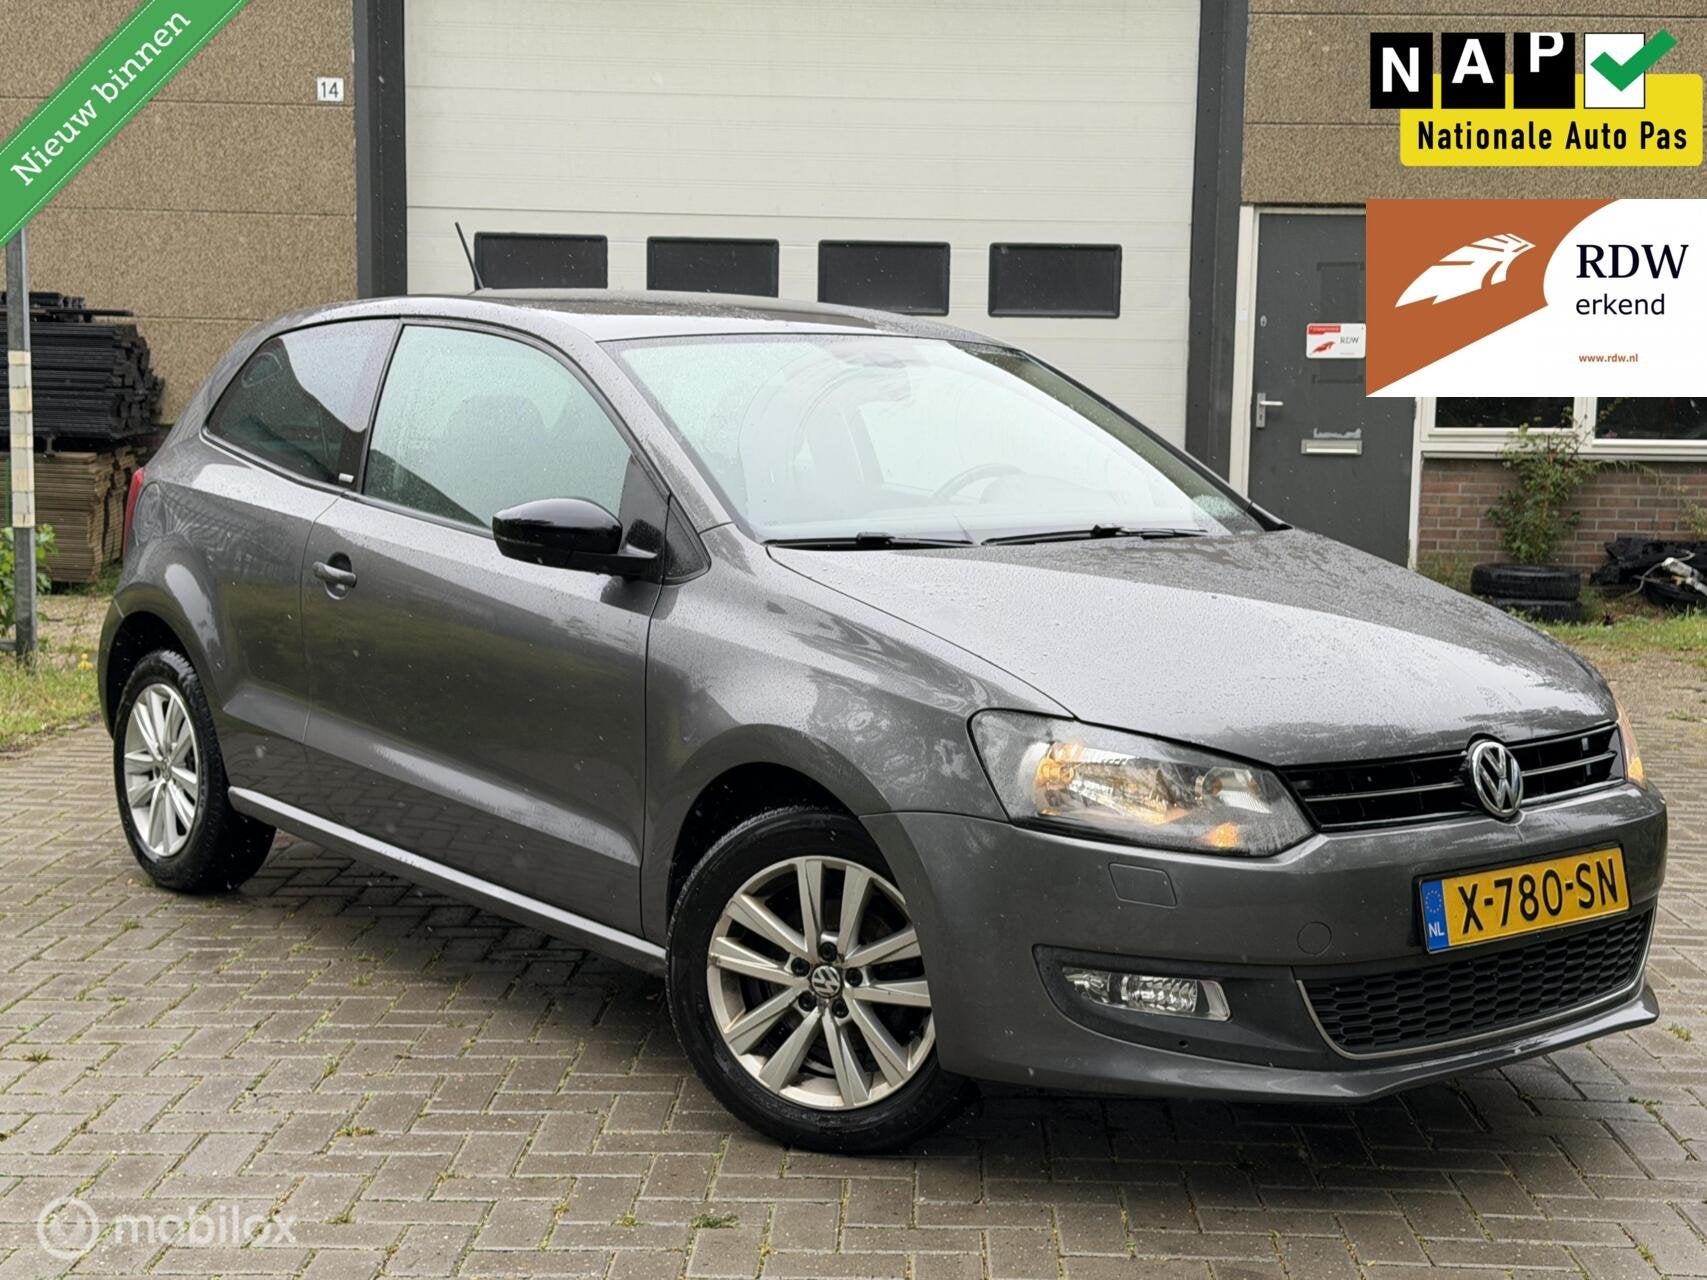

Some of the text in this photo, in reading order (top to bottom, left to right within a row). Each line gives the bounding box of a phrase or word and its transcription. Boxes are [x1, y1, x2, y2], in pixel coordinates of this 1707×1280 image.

[321, 82, 339, 98] 14
[1340, 336, 1359, 344] RDW
[1458, 858, 1619, 935] X-780-SN
[1428, 921, 1445, 937] NL
